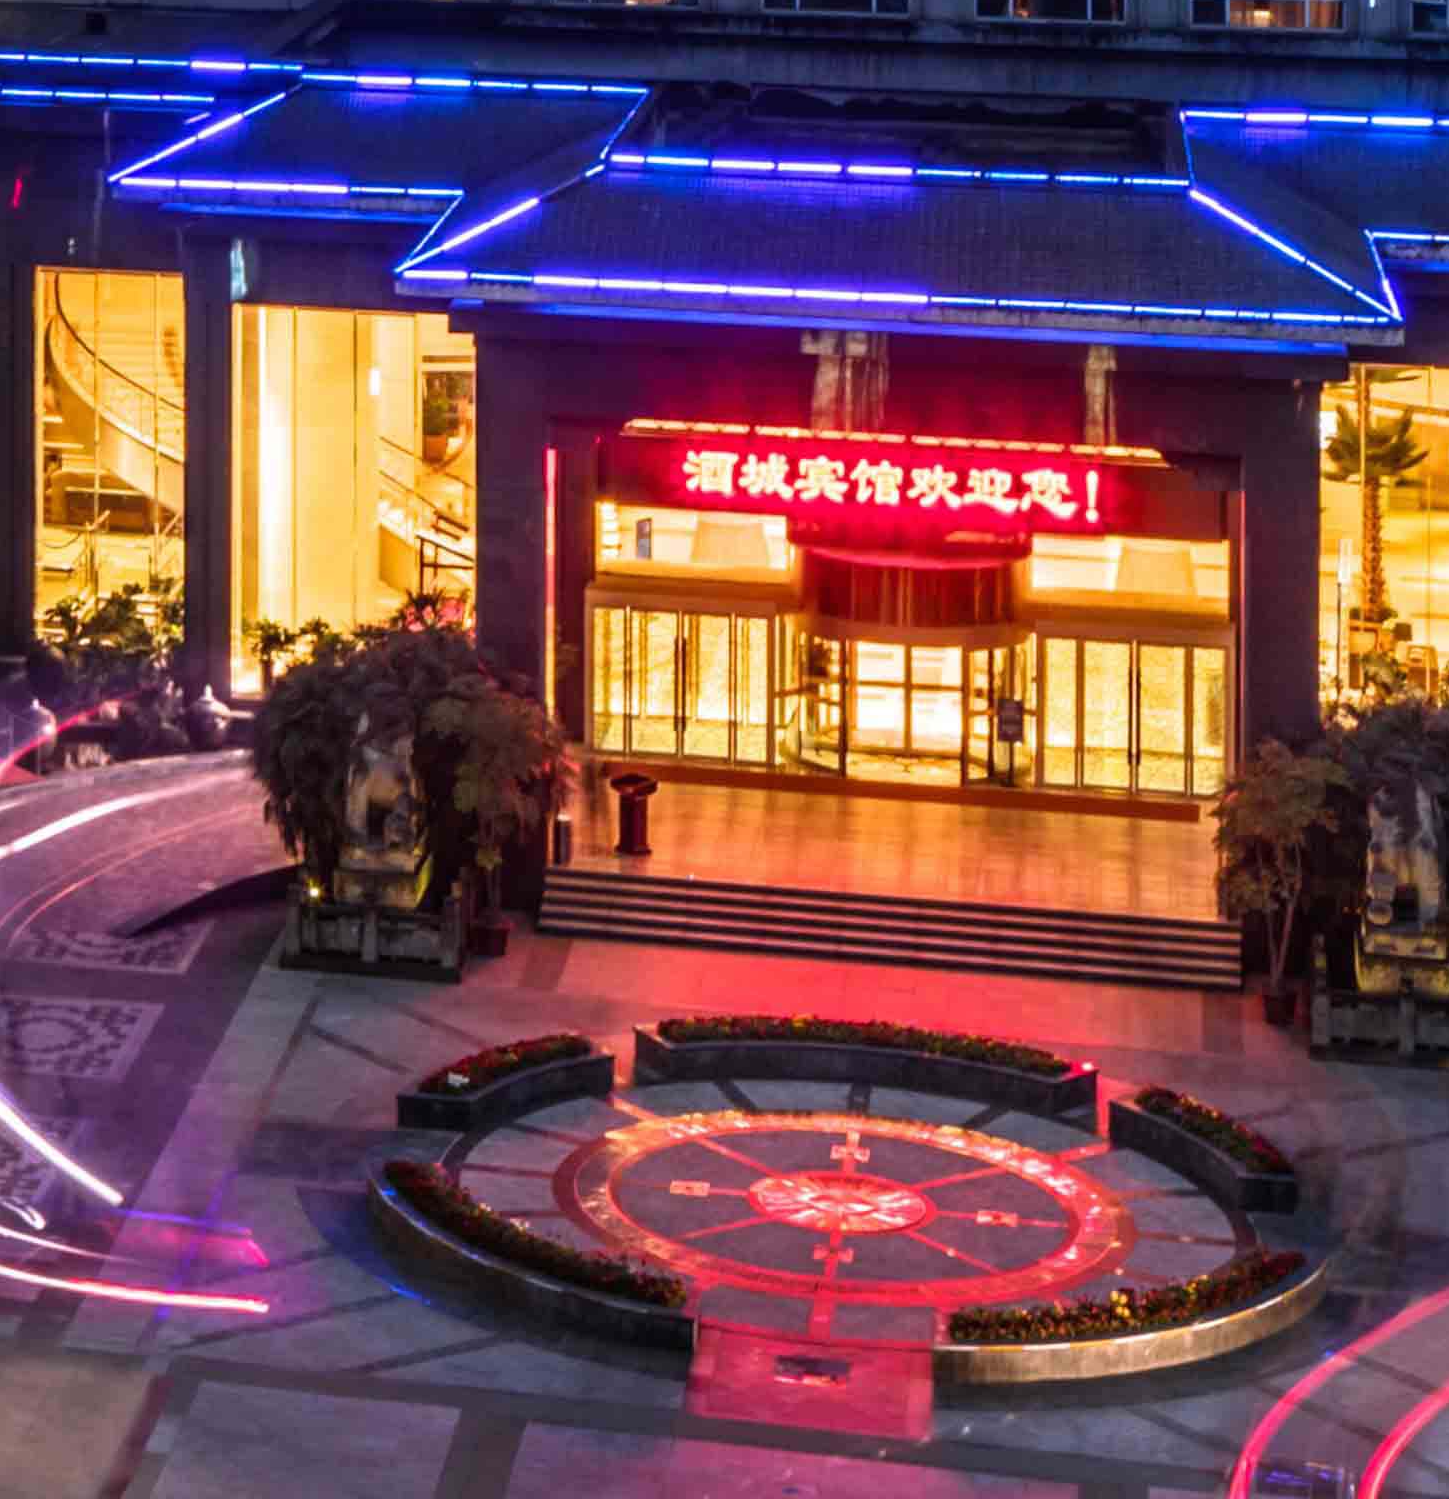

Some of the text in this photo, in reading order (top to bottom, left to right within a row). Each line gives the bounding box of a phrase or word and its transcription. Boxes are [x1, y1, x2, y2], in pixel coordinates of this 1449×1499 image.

[682, 448, 1101, 524] 酒城宾馆欢迎您！
